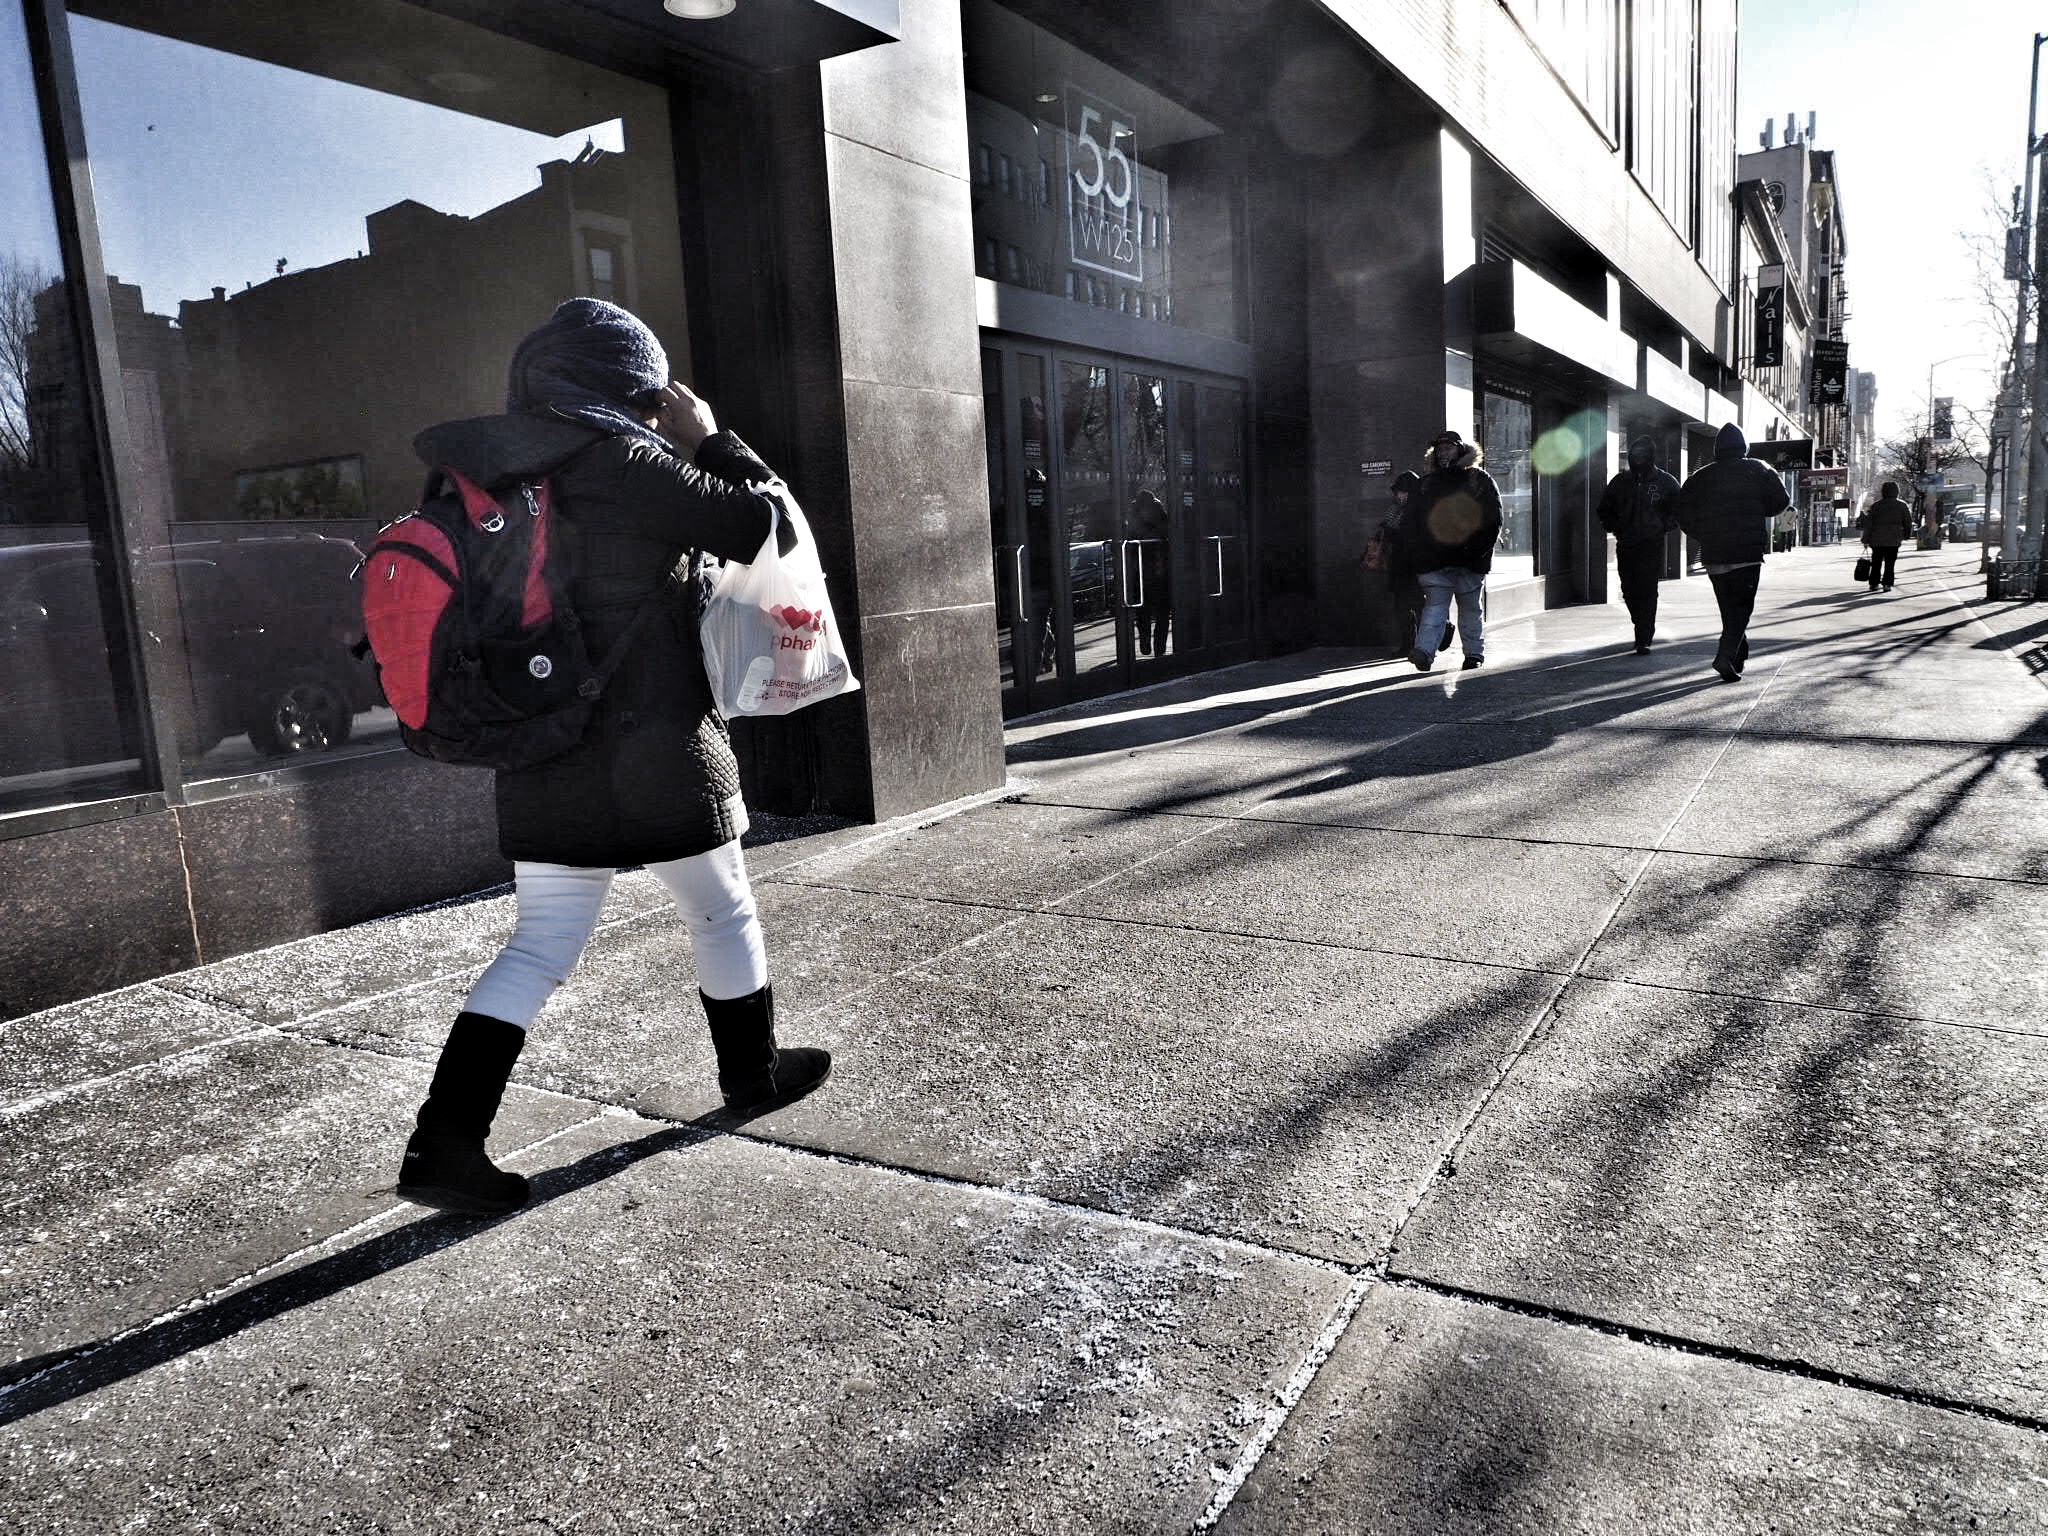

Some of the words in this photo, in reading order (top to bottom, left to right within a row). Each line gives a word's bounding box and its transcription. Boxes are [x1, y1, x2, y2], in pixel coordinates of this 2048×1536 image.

[1074, 105, 1132, 208] 55
[1759, 285, 1783, 364] Nails
[761, 679, 785, 688] PLEASE
[779, 690, 800, 699] STORE
